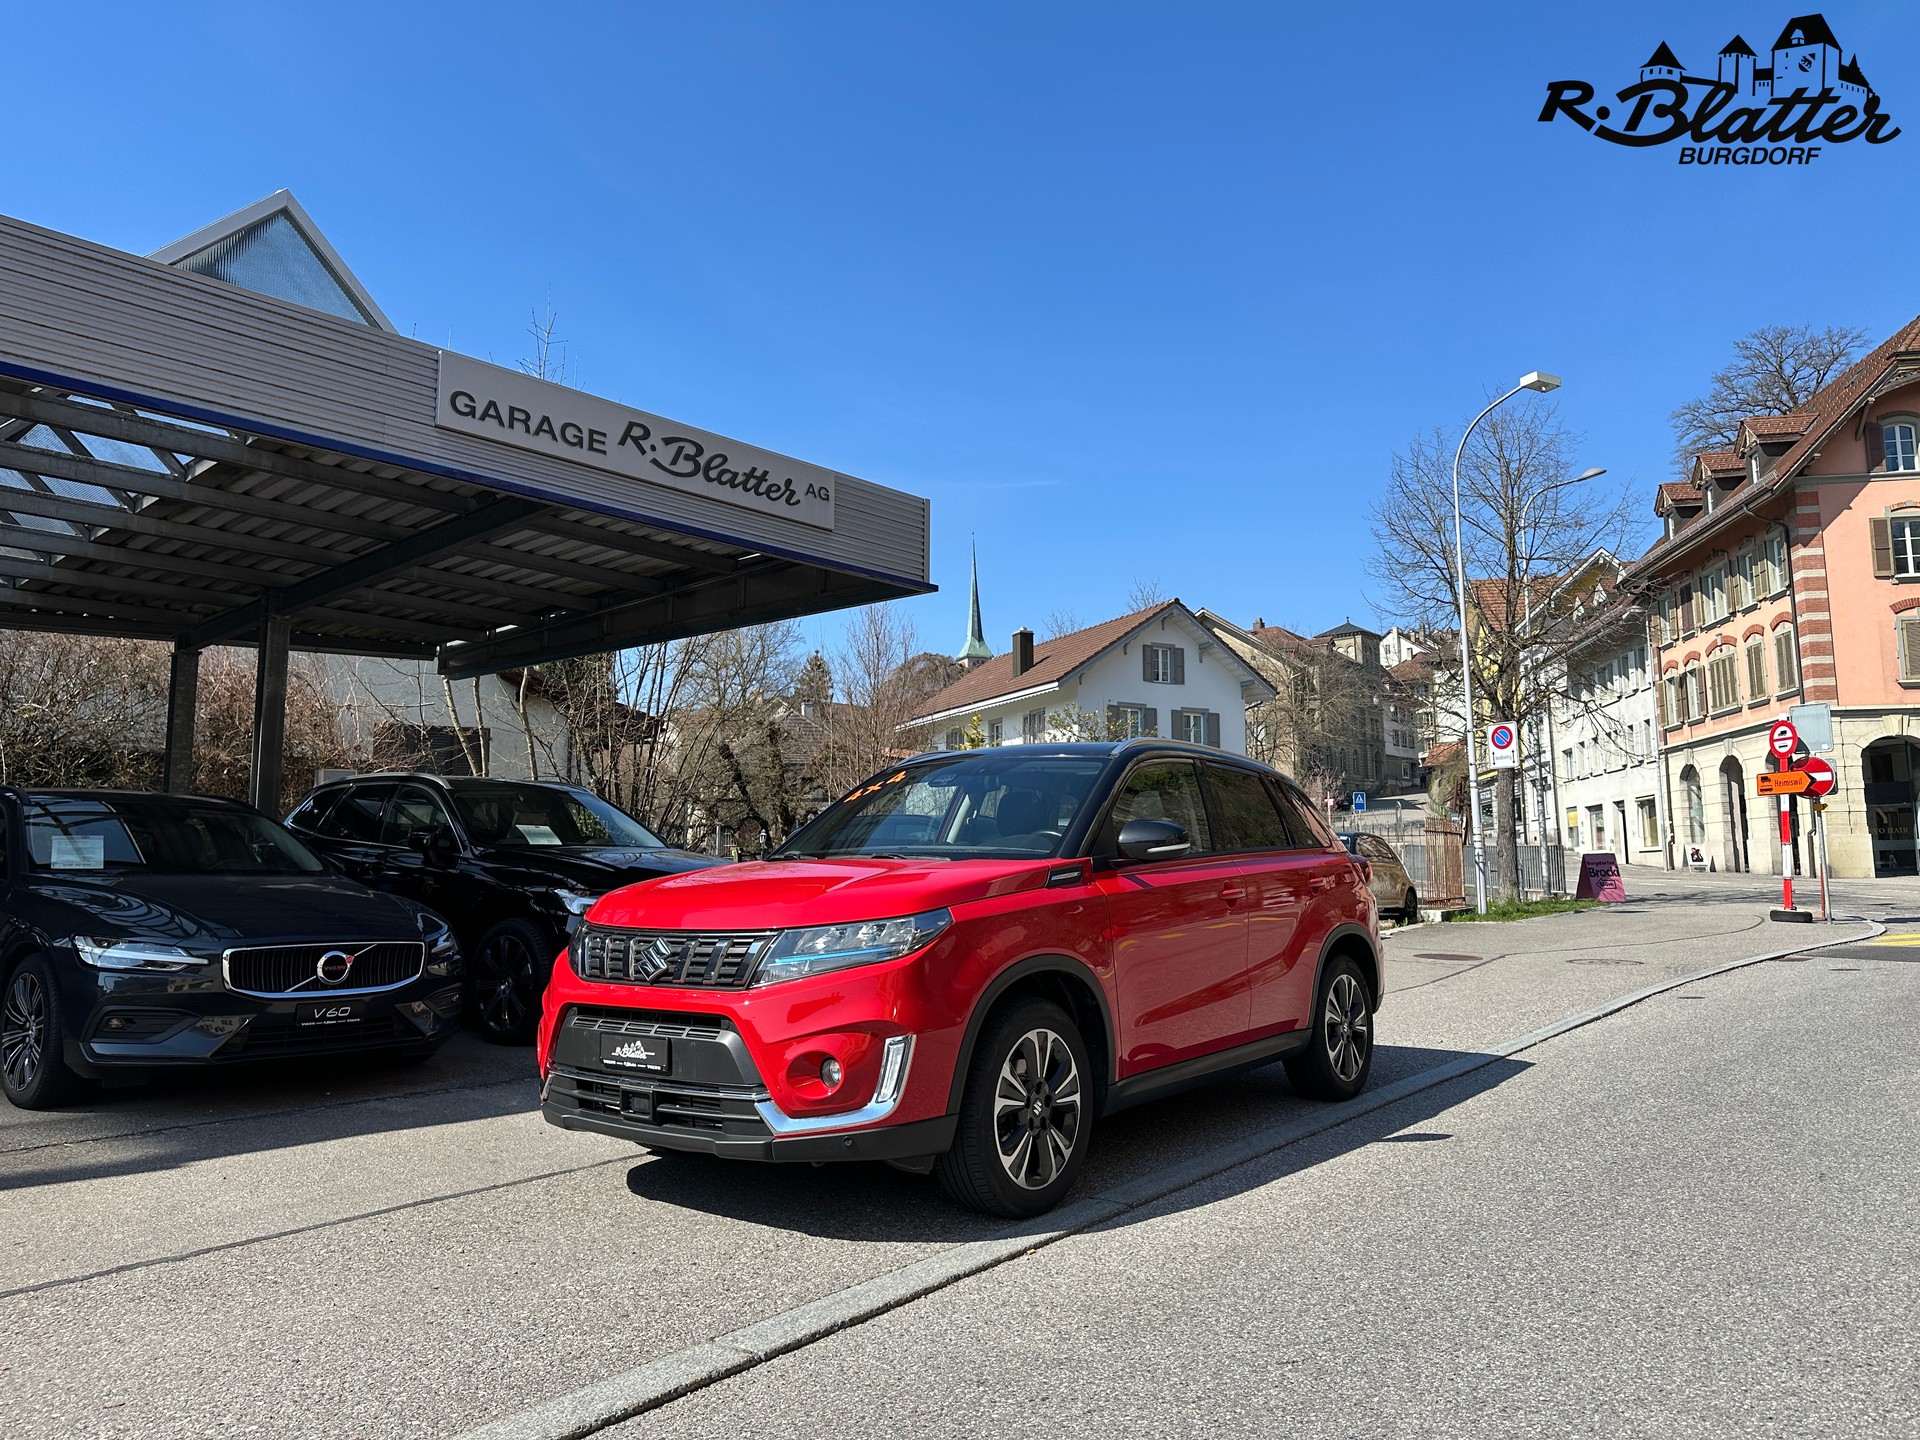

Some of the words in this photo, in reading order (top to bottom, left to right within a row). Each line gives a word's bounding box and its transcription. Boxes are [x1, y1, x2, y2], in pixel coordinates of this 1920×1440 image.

[449, 390, 607, 456] GARAGE
[804, 482, 830, 502] AG
[1588, 866, 1620, 877] Brocki
[314, 1006, 351, 1018] V60
